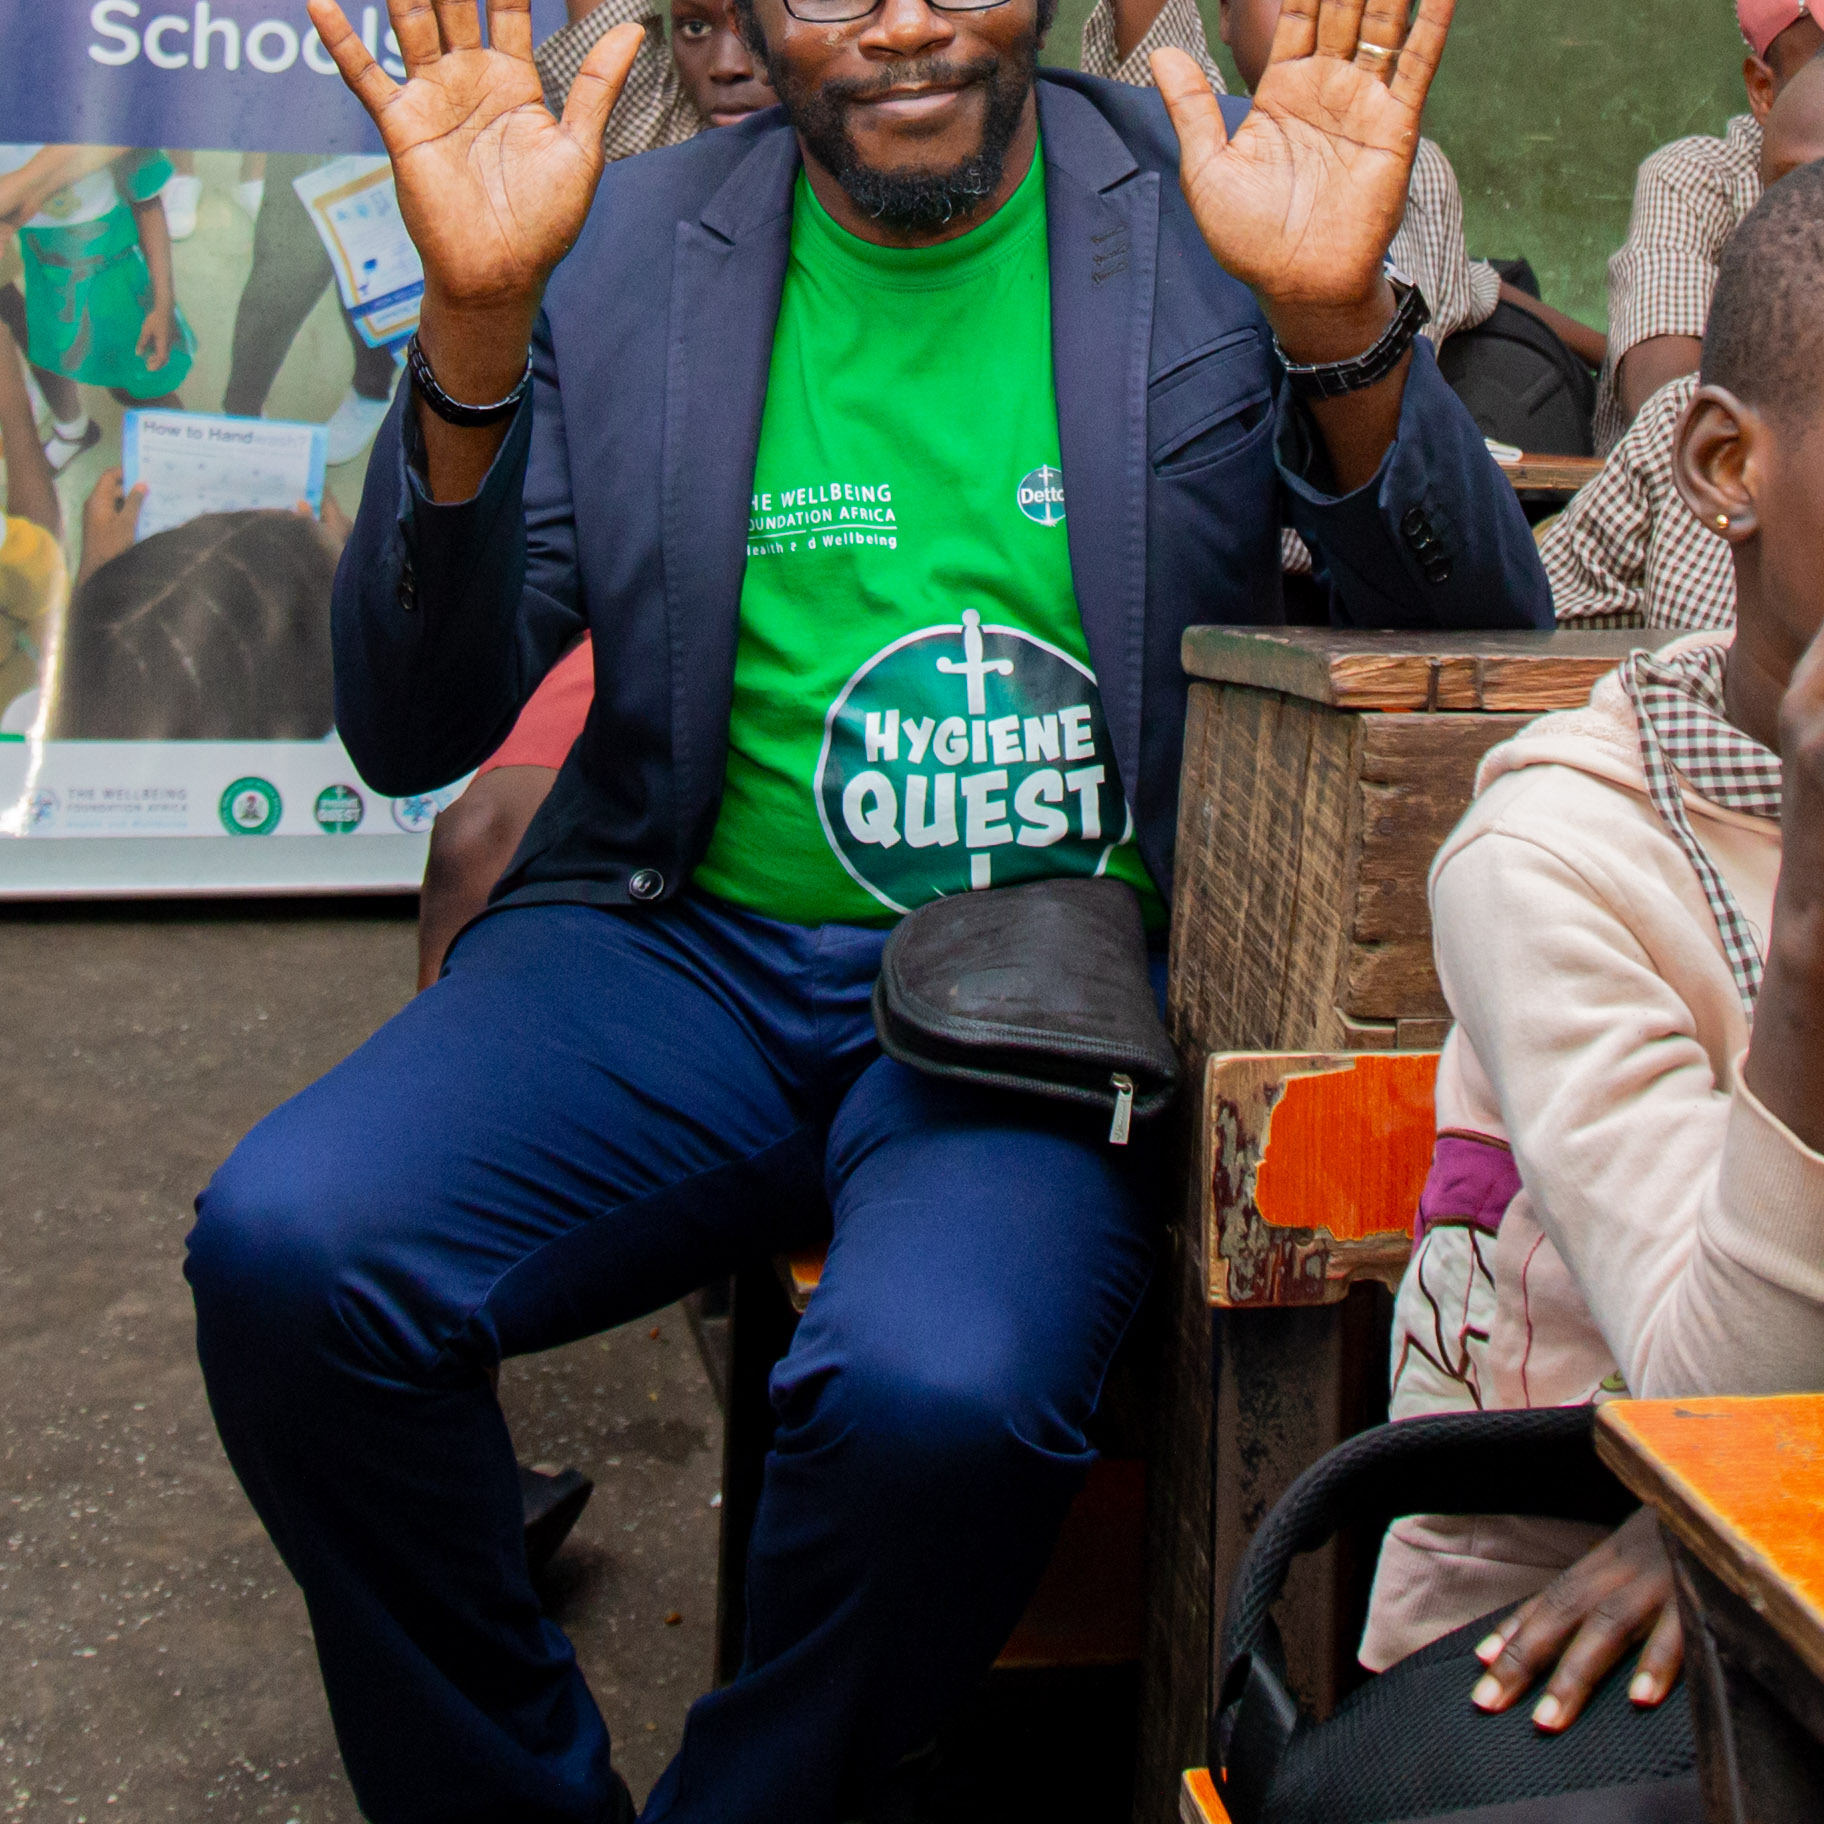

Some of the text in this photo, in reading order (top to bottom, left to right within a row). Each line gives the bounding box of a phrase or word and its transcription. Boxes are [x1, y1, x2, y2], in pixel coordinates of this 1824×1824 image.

[143, 420, 181, 437] How
[186, 425, 203, 440] to
[751, 482, 892, 512] HE WELLBEING
[1020, 486, 1066, 505] Detto
[748, 506, 897, 532] OUNDATION AFRICA
[822, 531, 898, 550] Wellbeing
[863, 703, 1097, 767] HYGIENE
[67, 787, 97, 801] THE
[840, 763, 1106, 850] QUEST
